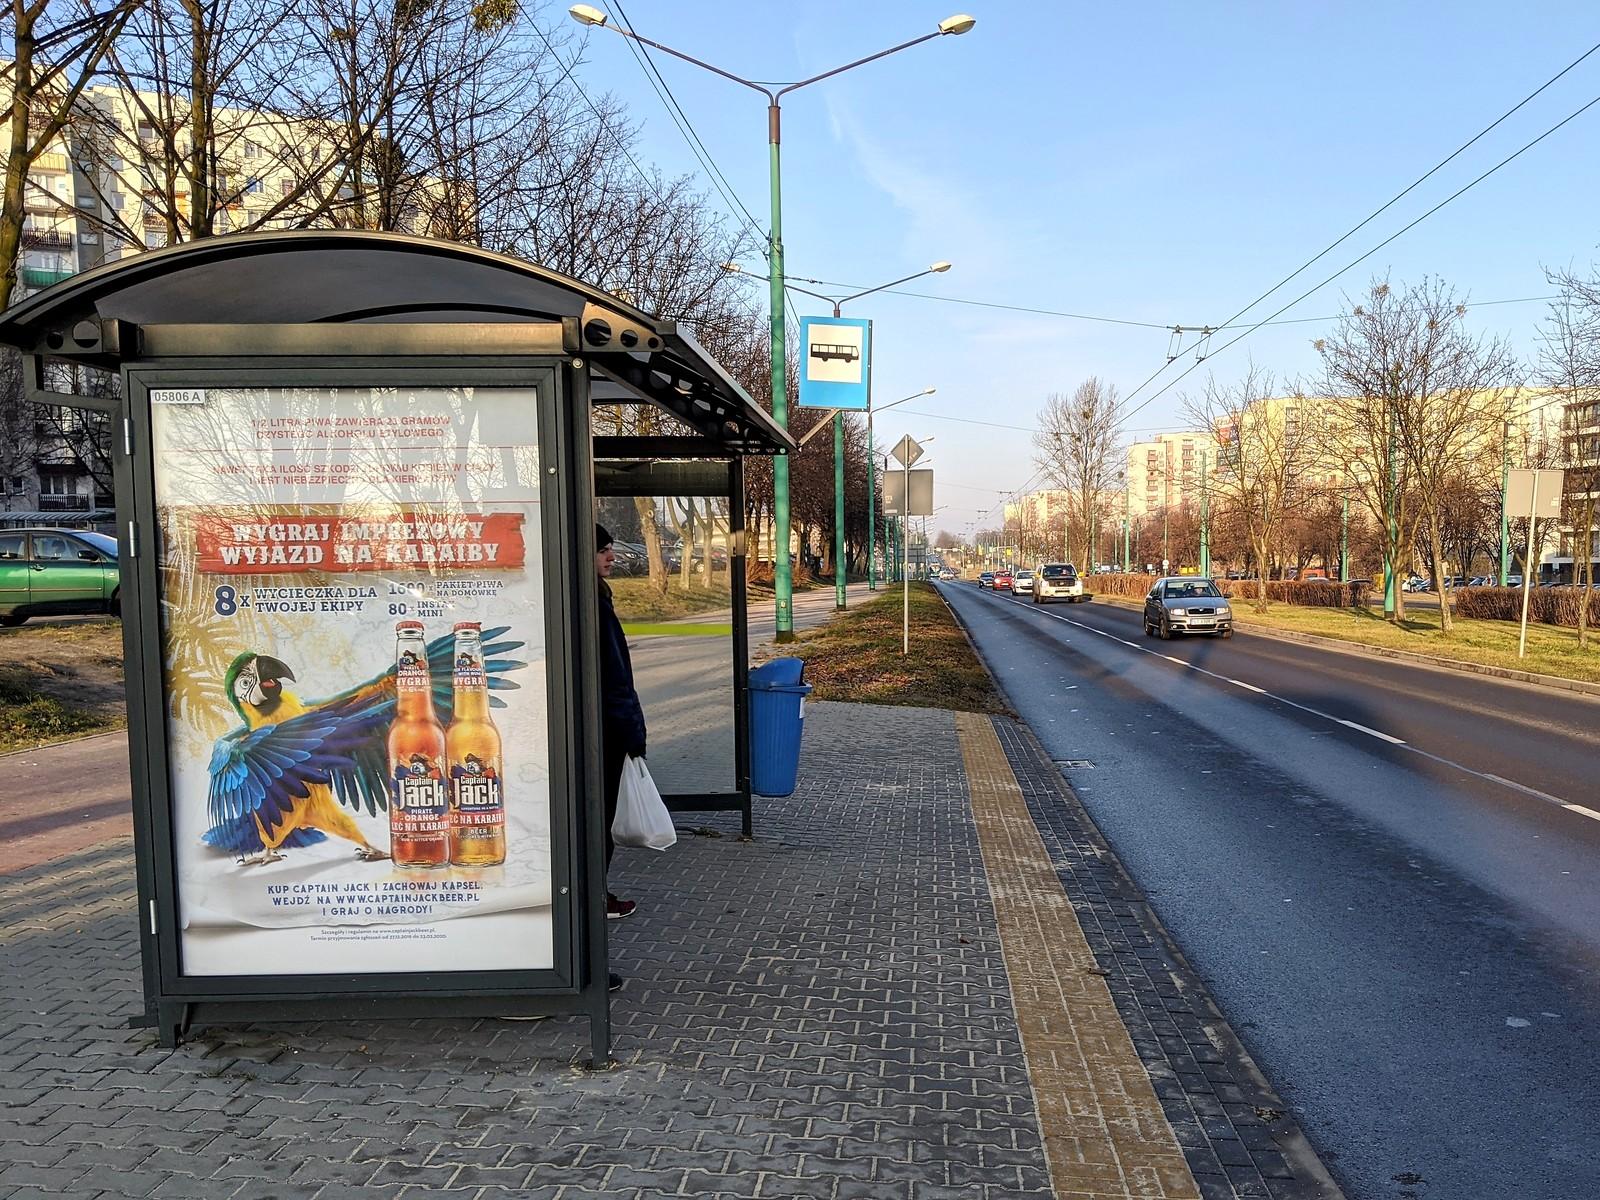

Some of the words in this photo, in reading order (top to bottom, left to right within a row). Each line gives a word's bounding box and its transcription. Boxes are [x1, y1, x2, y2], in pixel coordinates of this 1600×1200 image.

[154, 391, 187, 401] 05806
[189, 391, 201, 401] A
[270, 418, 301, 427] LITRA
[304, 417, 331, 426] PIWA
[335, 416, 383, 426] ZAWIERA
[316, 429, 376, 438] ALKOHOLU
[283, 475, 364, 485] NIEBEZPIECZ
[230, 522, 330, 542] WYGRAJ
[341, 521, 484, 541] IMPREZOWY
[219, 545, 325, 566] WYJAZD
[334, 544, 374, 564] NA
[385, 543, 499, 563] KARAIBY
[436, 581, 473, 589] PAKIET
[476, 580, 504, 589] PIWA
[254, 587, 345, 599] WYCIECZKA
[348, 587, 378, 598] DLA
[452, 589, 497, 597] DOMÓWKĘ
[215, 585, 237, 615] 8
[255, 602, 316, 613] TWOJEJ
[320, 601, 364, 612] EKIPY
[389, 603, 407, 615] 80
[405, 777, 433, 786] Captain
[460, 775, 487, 785] Captain
[399, 779, 444, 811] Jack
[453, 778, 500, 810] Jack
[474, 812, 504, 824] KARAIB
[420, 820, 450, 831] KARAIB
[268, 885, 289, 894] KUP
[293, 884, 338, 893] CAPTAIN
[344, 883, 370, 892] JACK
[383, 882, 437, 891] ZACHOWAJ
[272, 895, 310, 906] WEJDŹ
[317, 896, 331, 904] NA
[336, 893, 480, 904] WWW.CAPTAINJACKBEER.PL
[331, 906, 360, 915] GRAJ
[364, 906, 372, 915] O
[377, 905, 432, 915] NAGRODY!
